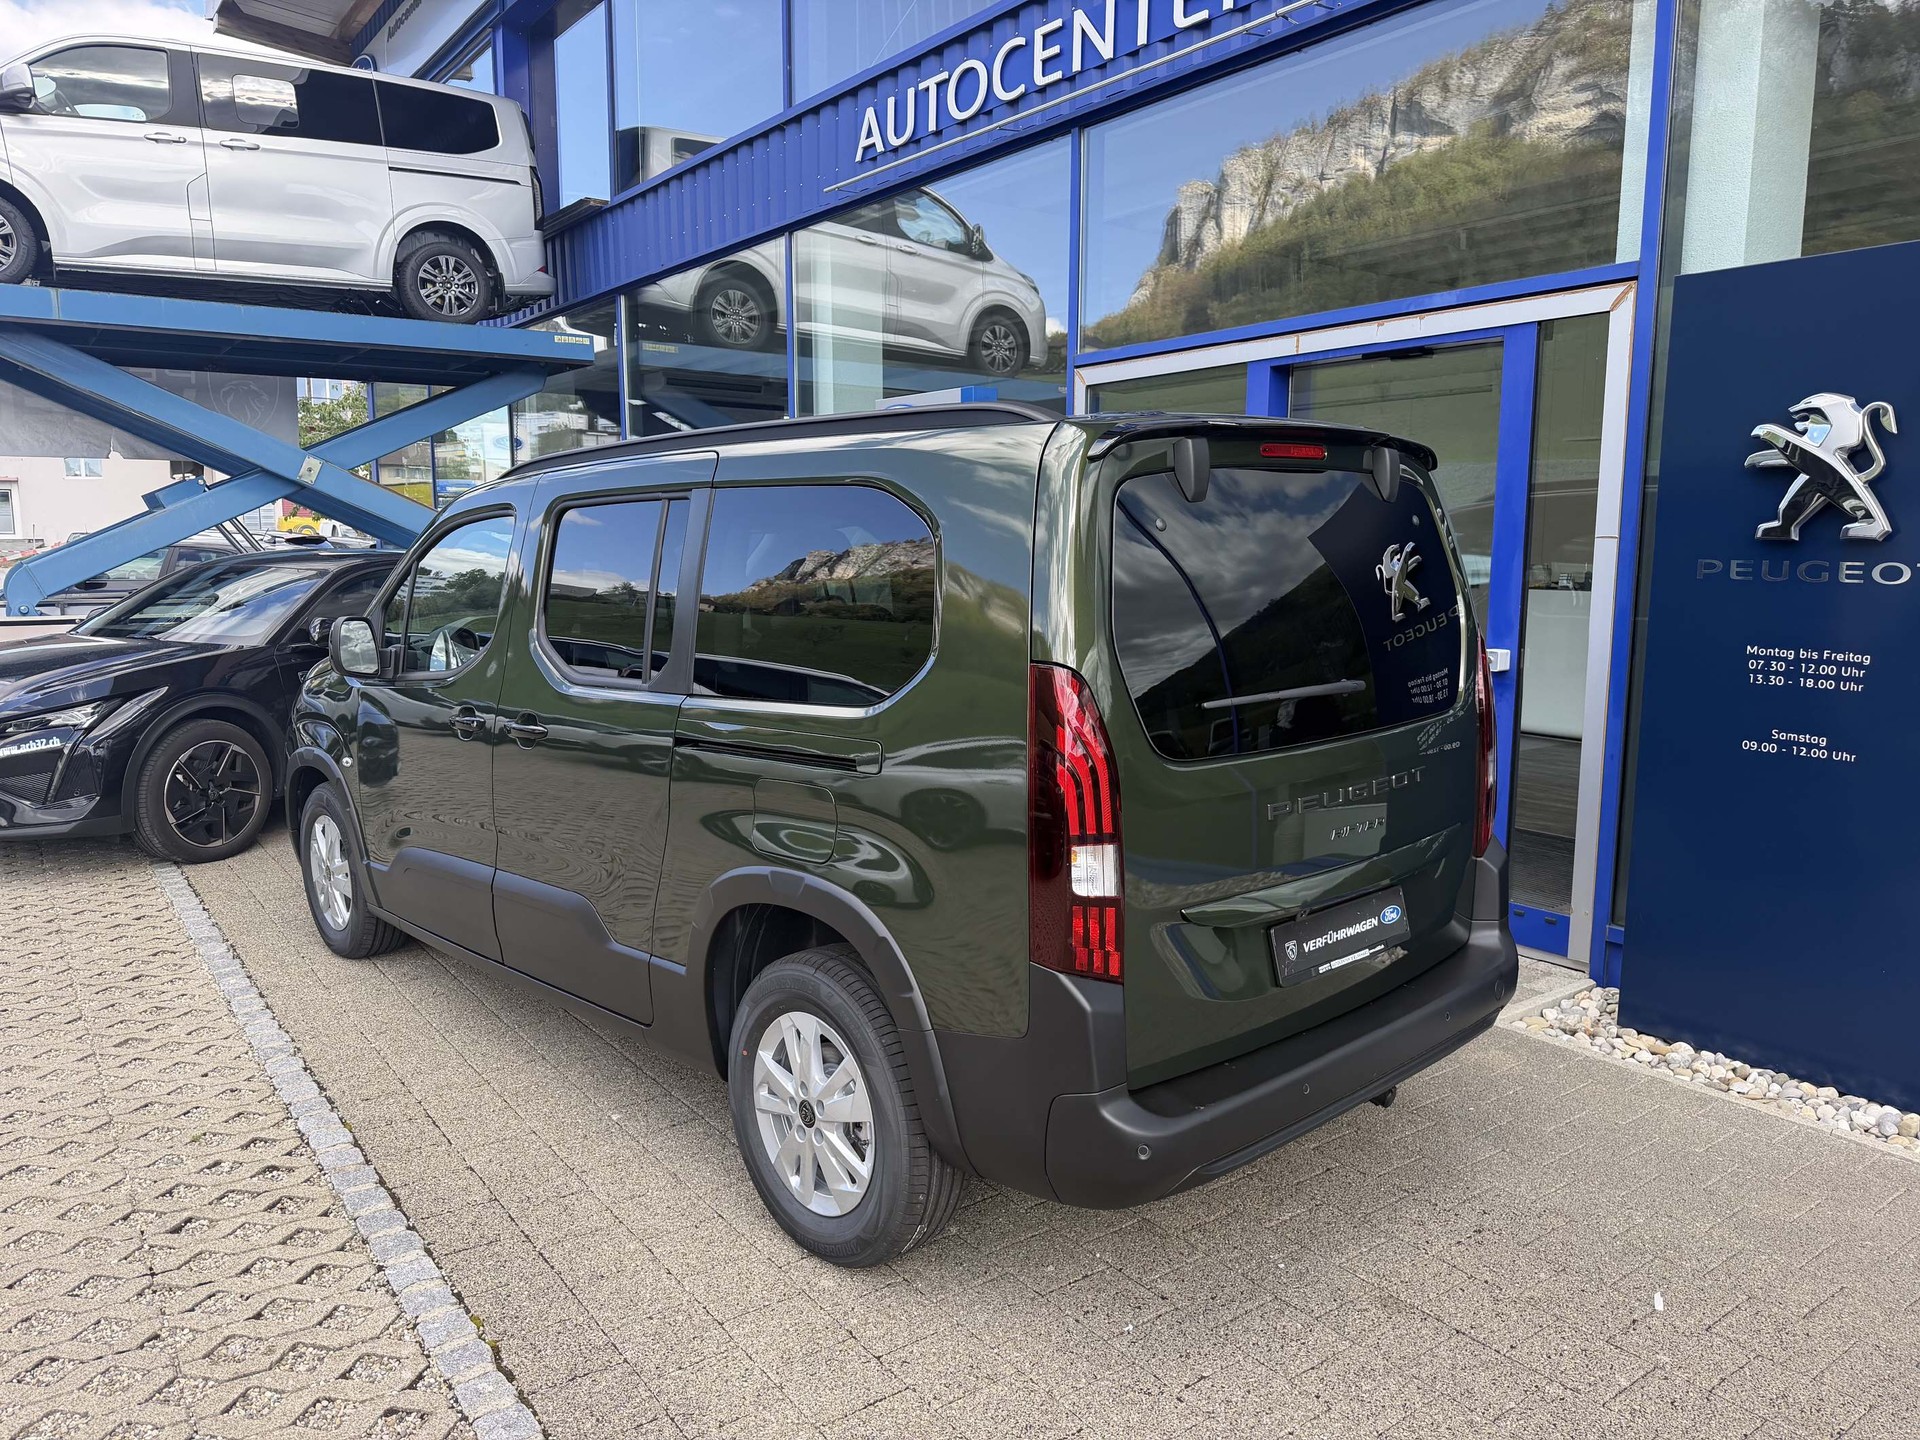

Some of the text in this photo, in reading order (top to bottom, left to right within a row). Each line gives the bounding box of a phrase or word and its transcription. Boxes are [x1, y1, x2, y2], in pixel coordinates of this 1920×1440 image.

[855, 0, 1234, 163] AUTOCENT
[1696, 558, 1920, 585] PEUGEO
[1746, 645, 1871, 665] Montag bis Freitag
[1748, 659, 1785, 672] 07.30
[1800, 663, 1837, 676] 12.00
[1841, 666, 1866, 678] Uhr
[1749, 673, 1784, 686] 13.30
[1799, 677, 1835, 690] 18.00
[1840, 681, 1864, 692] Uhr
[1771, 729, 1827, 746] Samstag
[1742, 740, 1777, 753] 09.00
[1792, 746, 1828, 759] 12.00
[1832, 751, 1856, 762] Uhr
[1267, 766, 1426, 820] PEUGEOT
[1303, 916, 1378, 953] VERFÜHRWAGEN
